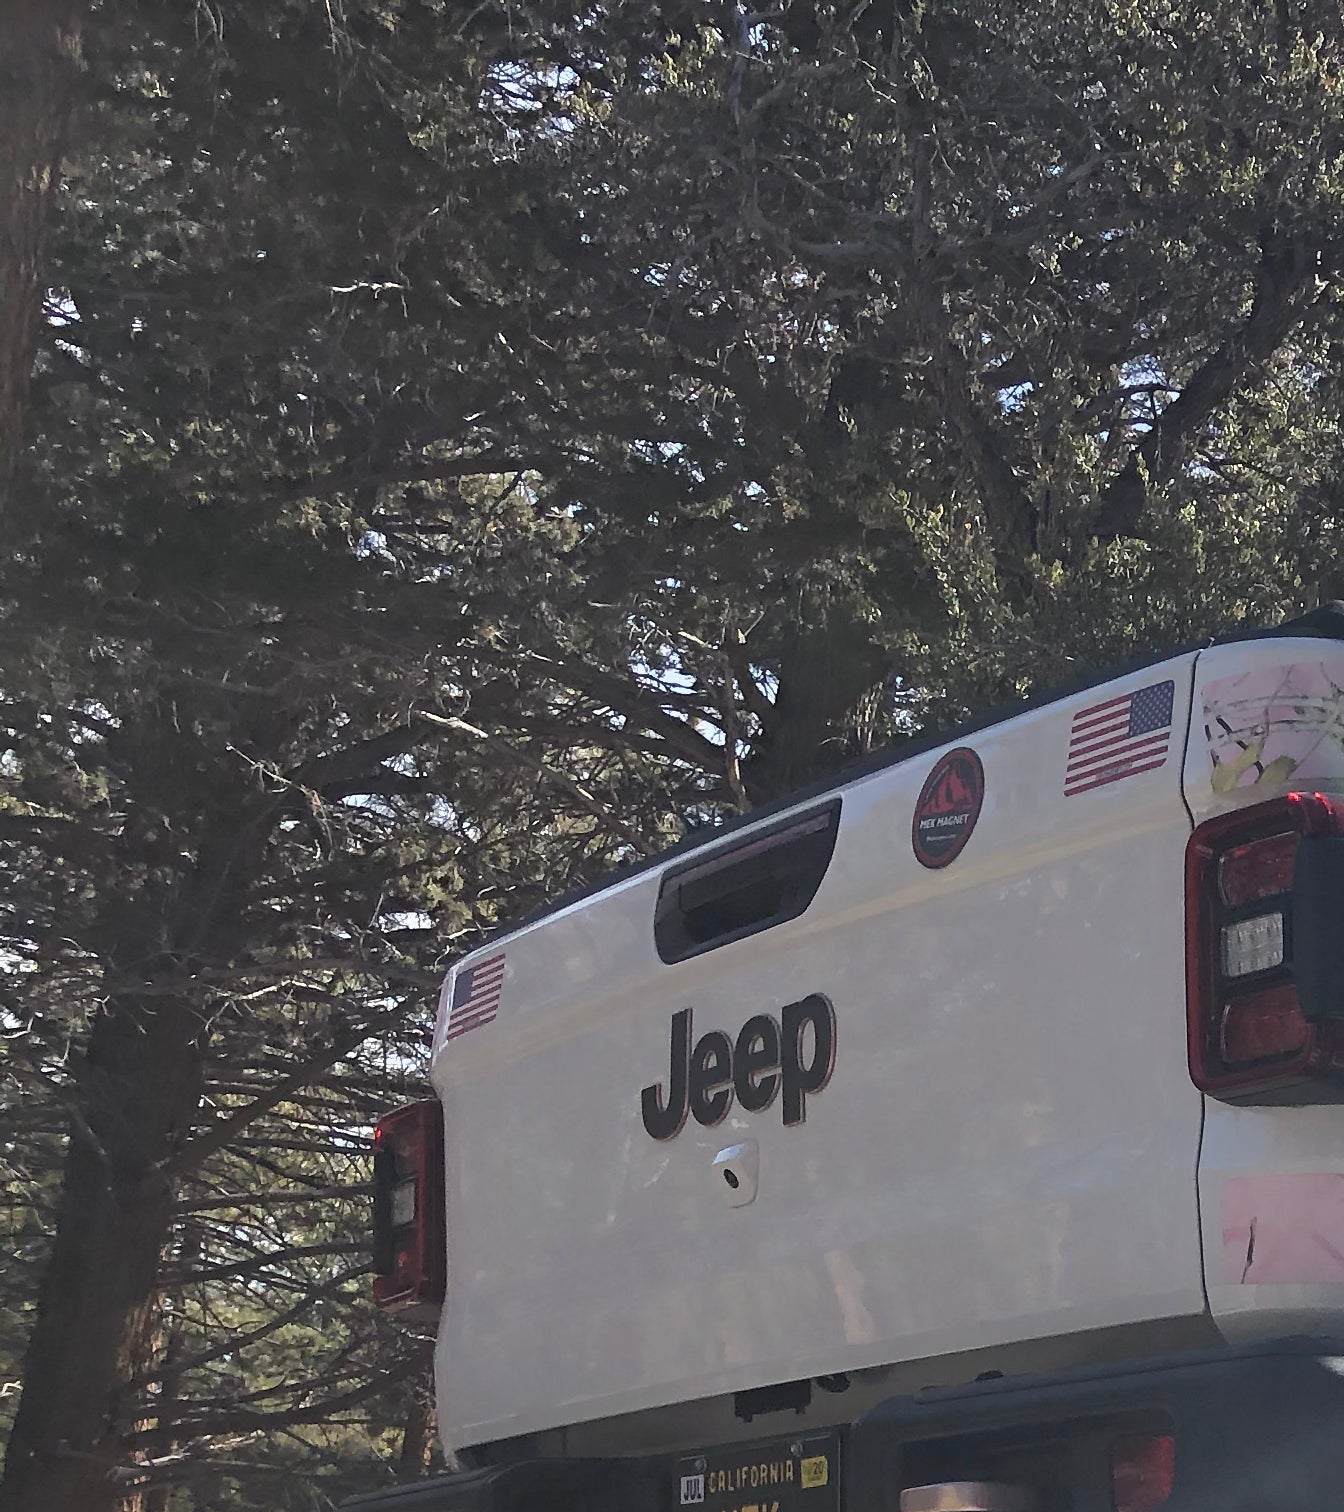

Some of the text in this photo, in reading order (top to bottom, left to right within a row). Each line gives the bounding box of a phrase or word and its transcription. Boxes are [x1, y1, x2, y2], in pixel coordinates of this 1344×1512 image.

[936, 813, 970, 827] MAGNET
[641, 992, 837, 1142] Jeep
[708, 1460, 794, 1494] CALIFORNIA
[812, 1461, 825, 1475] 20
[683, 1478, 702, 1501] JUL
